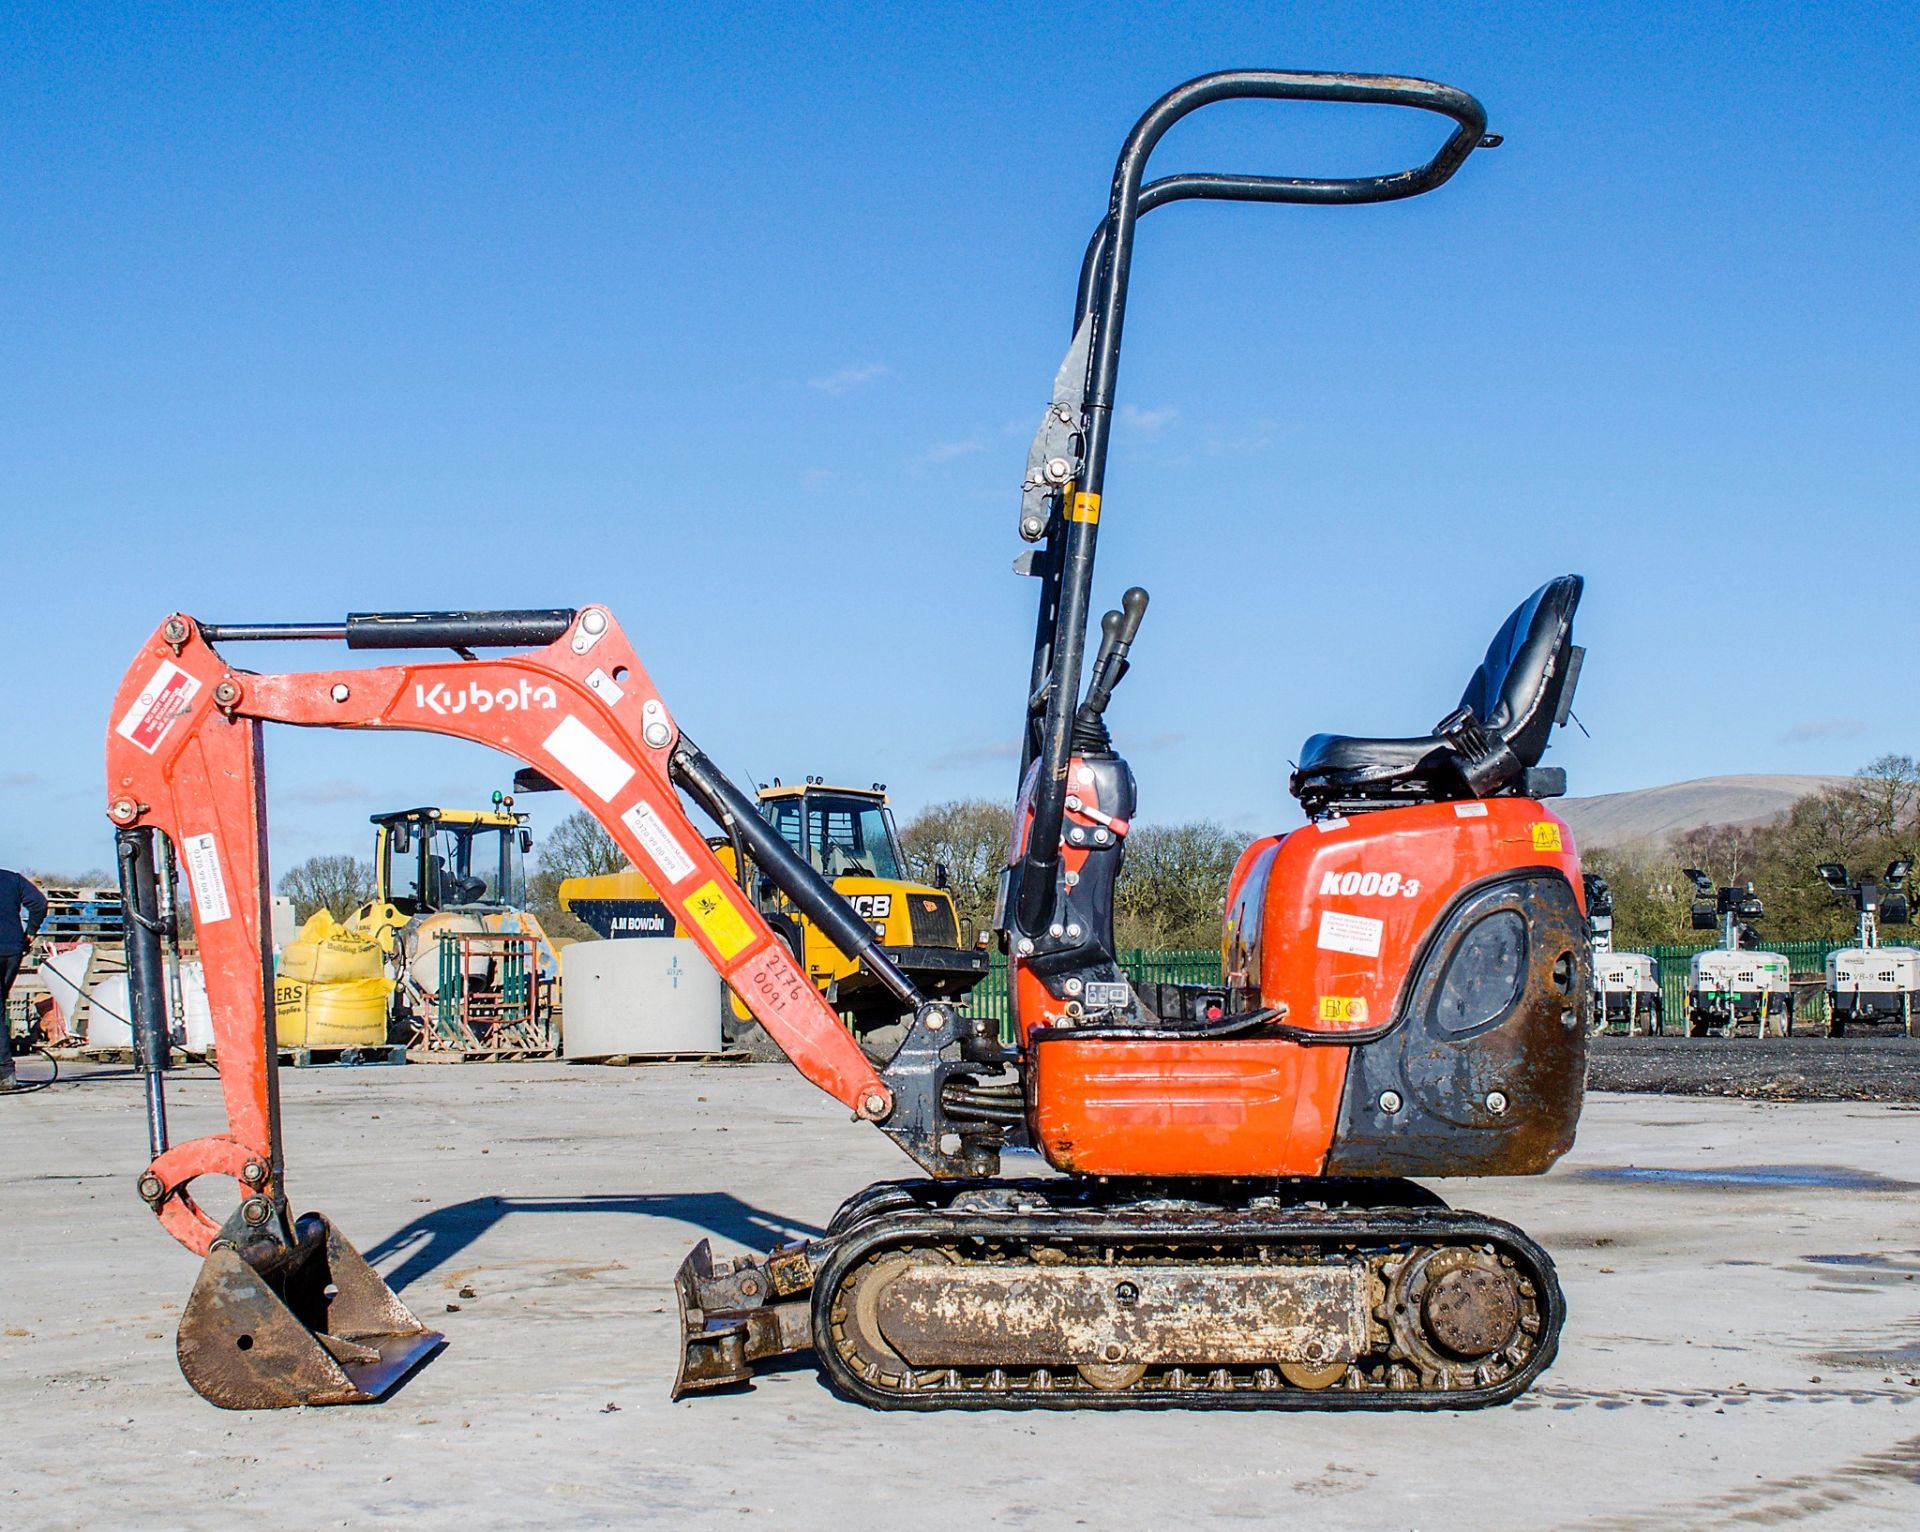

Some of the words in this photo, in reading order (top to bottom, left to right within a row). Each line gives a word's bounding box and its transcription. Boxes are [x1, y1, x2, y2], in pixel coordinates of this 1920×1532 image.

[143, 712, 154, 724] DO
[150, 701, 162, 714] NOT
[159, 688, 171, 702] USE
[415, 678, 557, 715] Kubota
[754, 972, 786, 1010] 0091
[766, 955, 802, 1000] 2276
